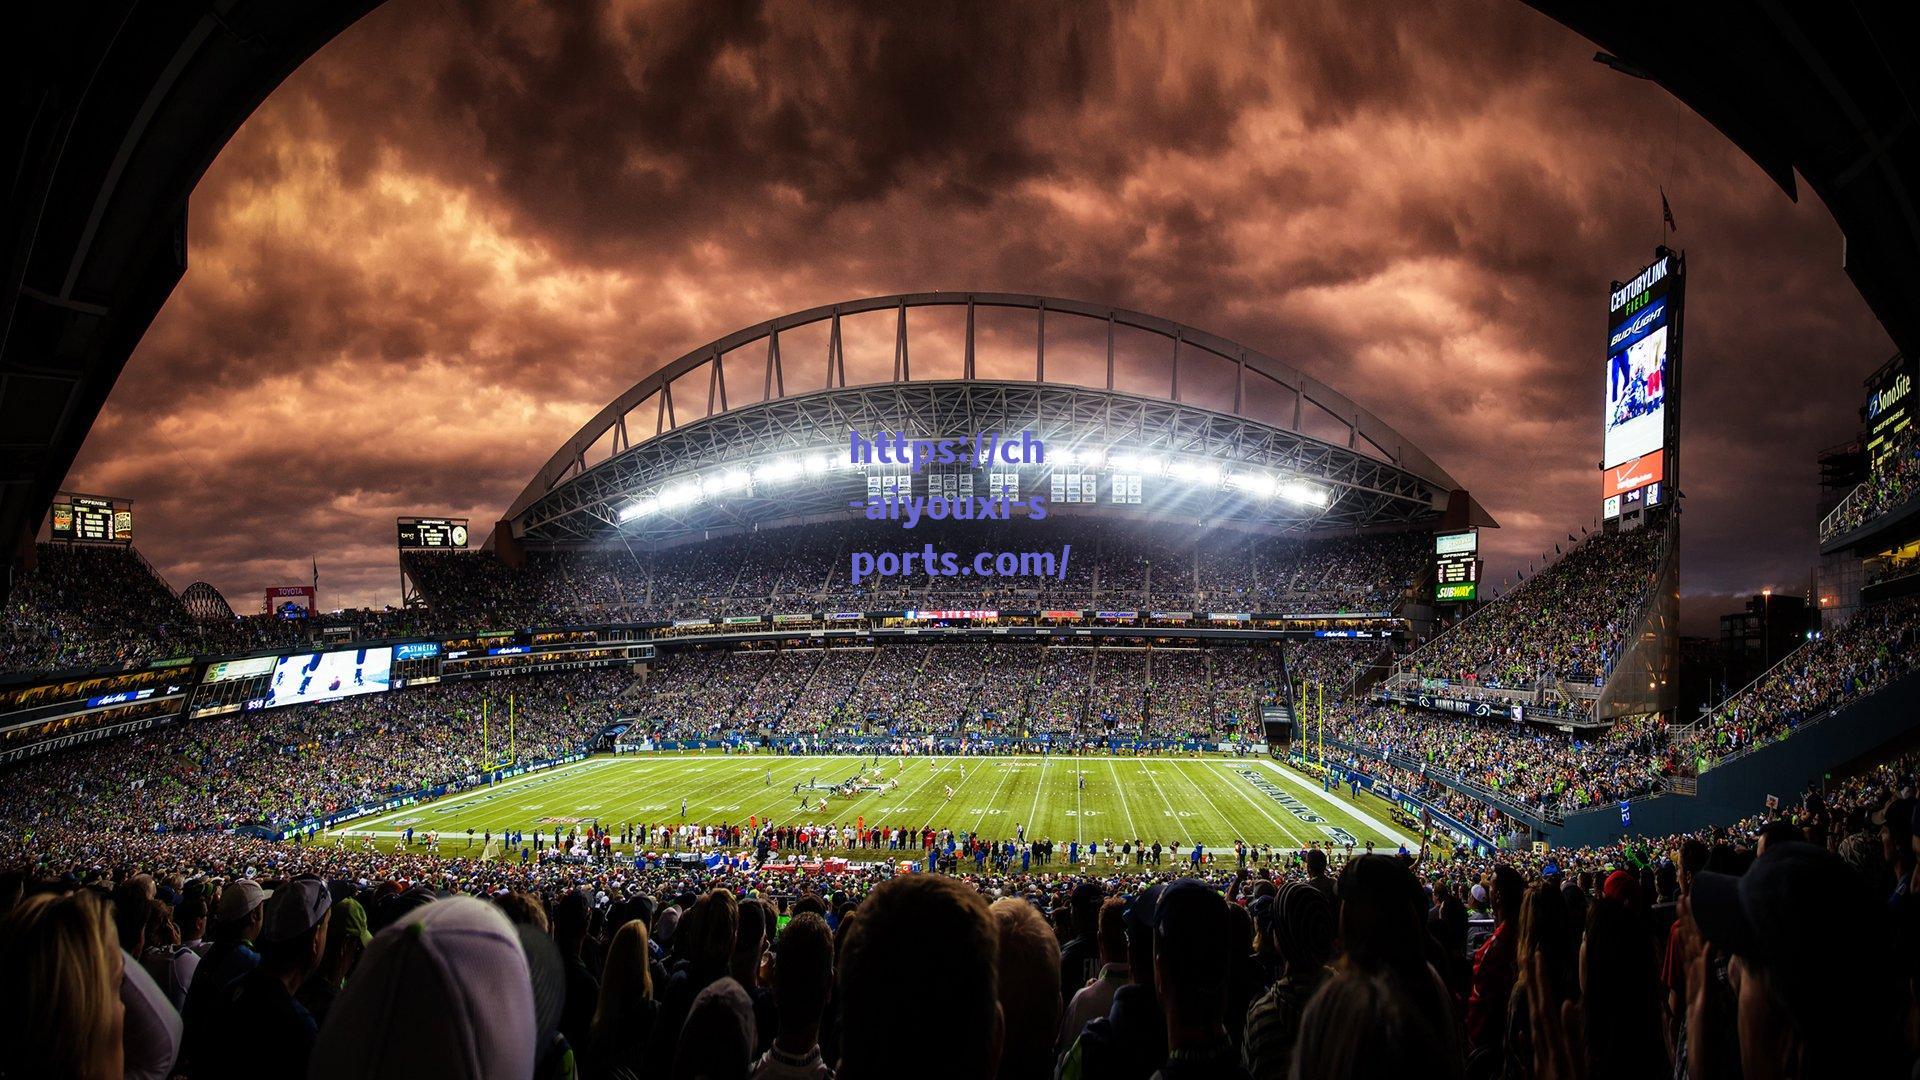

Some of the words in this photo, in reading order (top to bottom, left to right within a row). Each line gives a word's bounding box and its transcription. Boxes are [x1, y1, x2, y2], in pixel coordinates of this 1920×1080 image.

[1611, 256, 1669, 312] CENTURYLINK
[1626, 291, 1650, 316] FIELD
[1611, 327, 1632, 346] BUD
[1633, 306, 1664, 331] LIGHT
[1878, 373, 1912, 414] SonoSite
[1873, 407, 1905, 434] DEFENSE
[1437, 585, 1474, 598] SUBWAY
[410, 644, 438, 652] SYMETRA
[490, 668, 516, 676] HOME
[1435, 698, 1454, 711] HAWKS
[1455, 700, 1470, 712] NEST
[10, 750, 23, 762] TO
[30, 728, 112, 756] CENTURYLINK
[118, 721, 153, 735] FIELD
[1233, 769, 1327, 823] SEAHAWKS
[1620, 806, 1630, 822] 12
